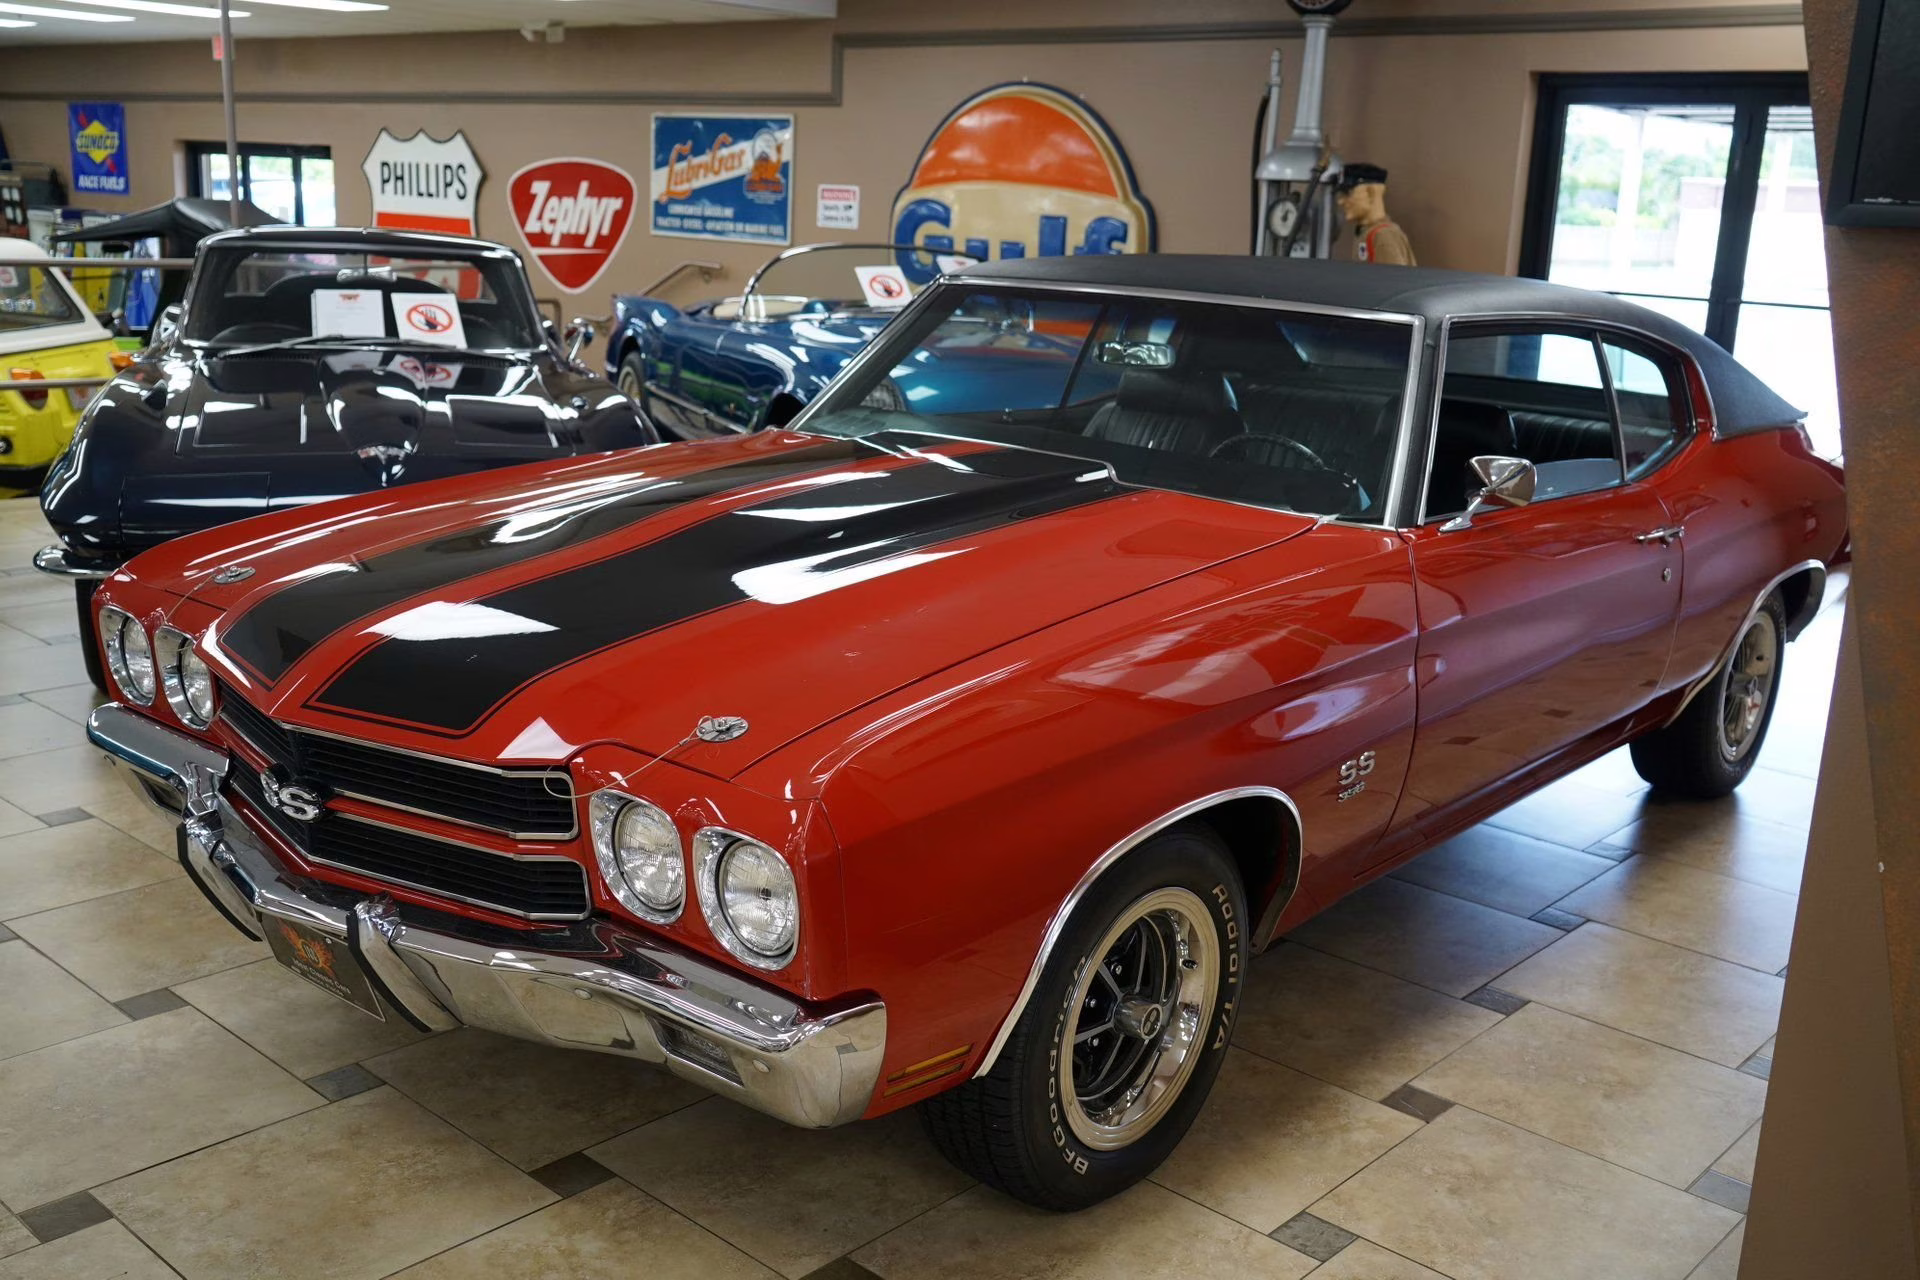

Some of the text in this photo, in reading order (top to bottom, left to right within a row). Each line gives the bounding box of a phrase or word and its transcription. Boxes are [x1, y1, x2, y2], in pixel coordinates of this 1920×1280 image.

[78, 134, 117, 150] SUNOCO
[78, 174, 127, 192] RACE FUELS
[380, 161, 468, 200] PHILLIPS
[524, 180, 624, 248] Zephyr
[1338, 750, 1377, 785] SS
[1212, 883, 1239, 1050] Radial T/A
